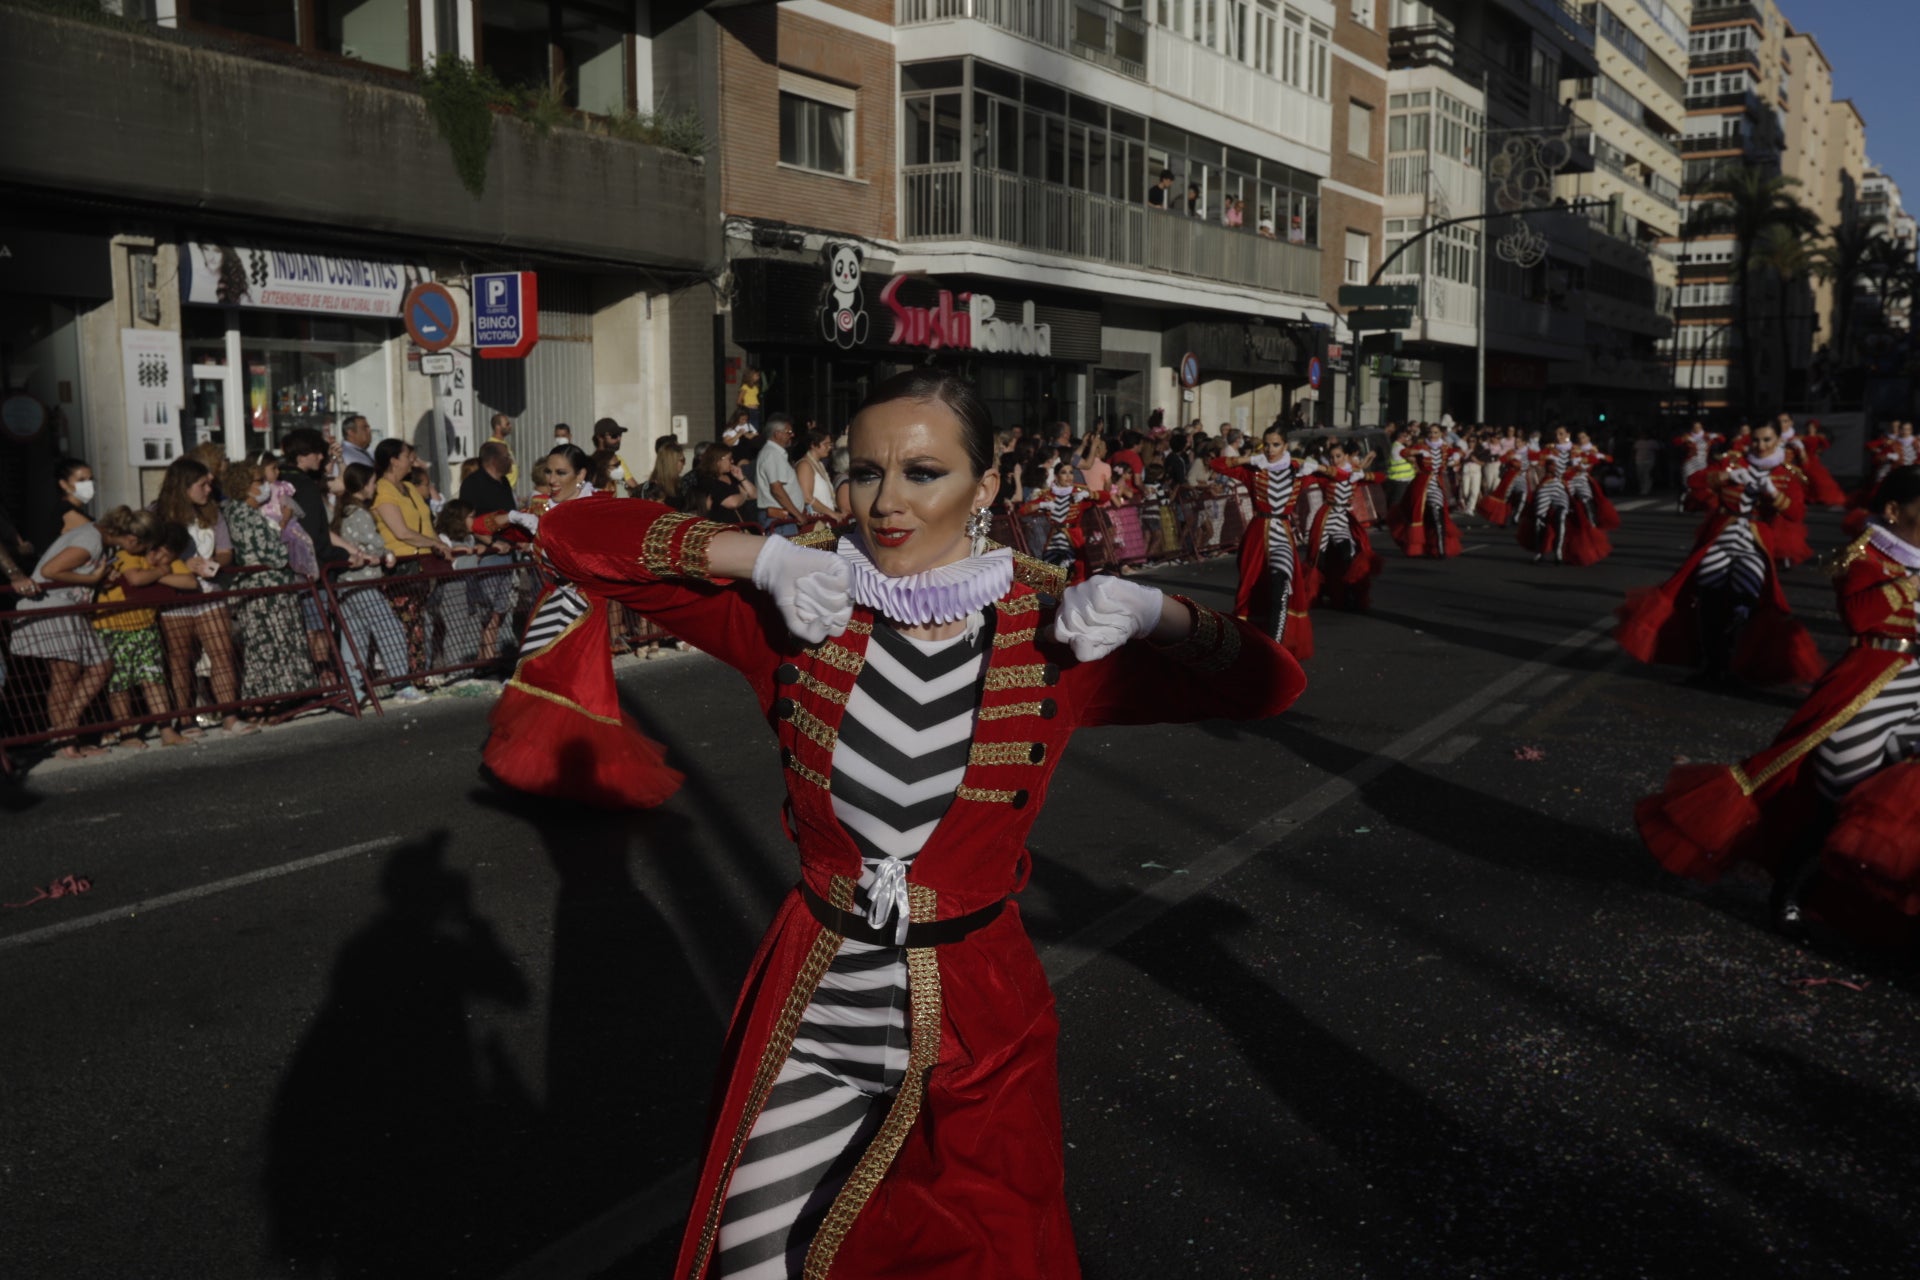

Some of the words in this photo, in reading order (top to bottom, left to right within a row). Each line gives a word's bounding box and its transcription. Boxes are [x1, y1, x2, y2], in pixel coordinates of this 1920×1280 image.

[326, 257, 398, 290] COSMETICS
[260, 290, 310, 308] EXTENSIONES
[310, 296, 322, 309] DE
[322, 296, 341, 310] PELO
[341, 298, 371, 312] NATURAL
[488, 280, 505, 305] P
[478, 315, 517, 330] BINGO
[879, 273, 970, 350] Sushi
[969, 293, 1051, 357] Panda
[478, 330, 518, 342] VICTORIA
